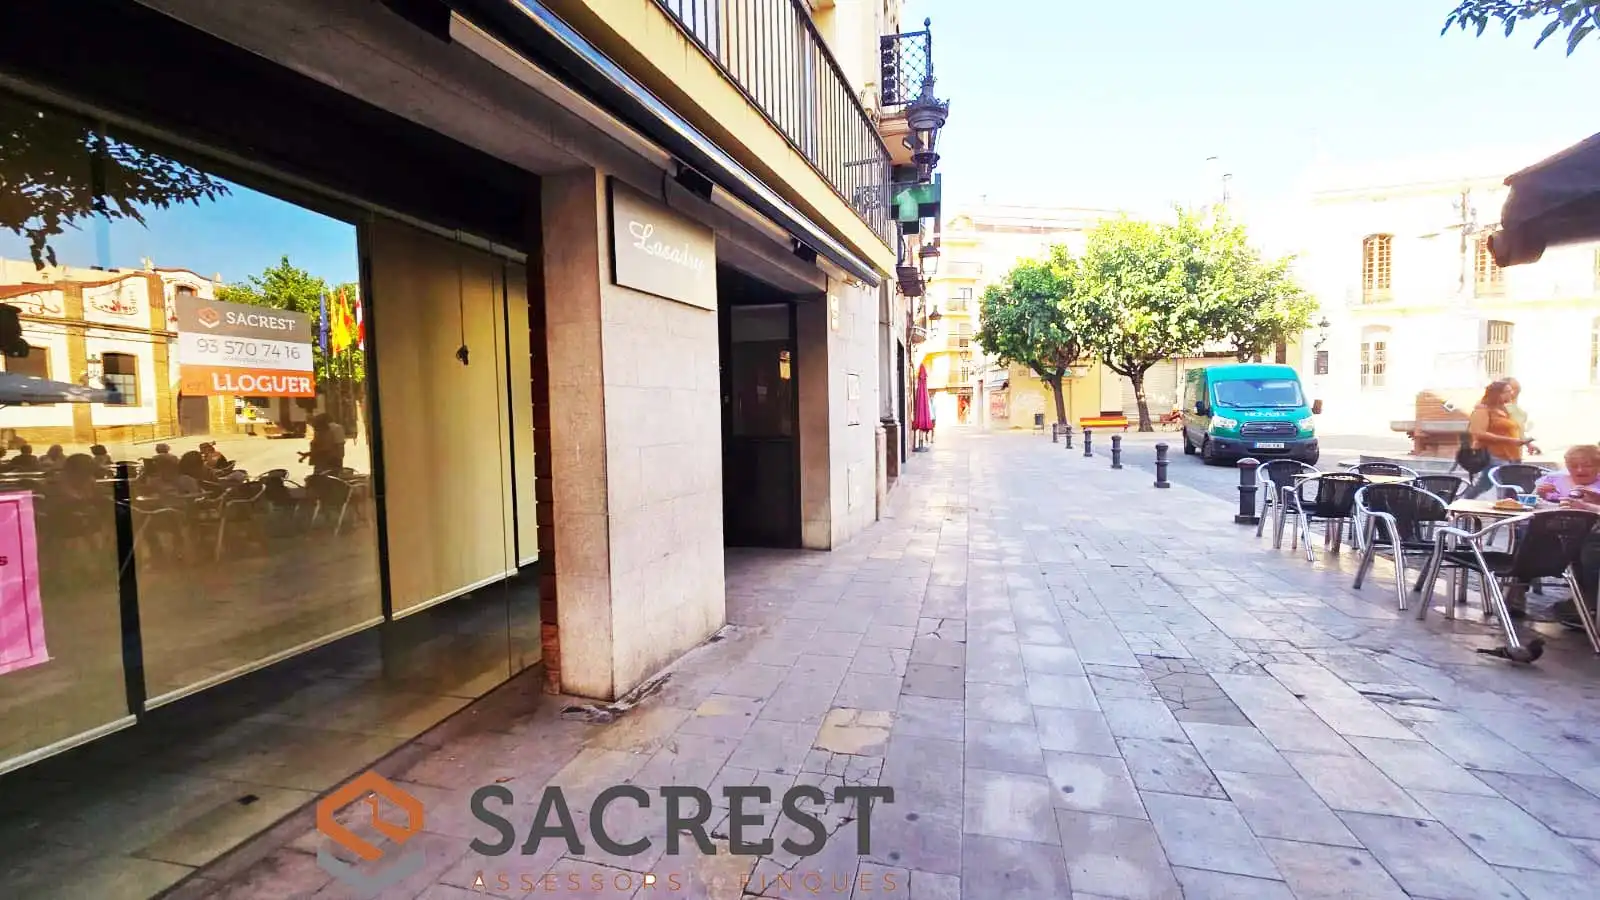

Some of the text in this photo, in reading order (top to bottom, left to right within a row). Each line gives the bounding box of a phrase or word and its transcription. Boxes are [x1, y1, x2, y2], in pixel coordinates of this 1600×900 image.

[226, 311, 296, 331] SACREST
[196, 338, 219, 354] 93
[224, 341, 257, 357] 570
[261, 343, 281, 358] 74
[284, 346, 301, 360] 16
[211, 372, 312, 393] LLOGUER
